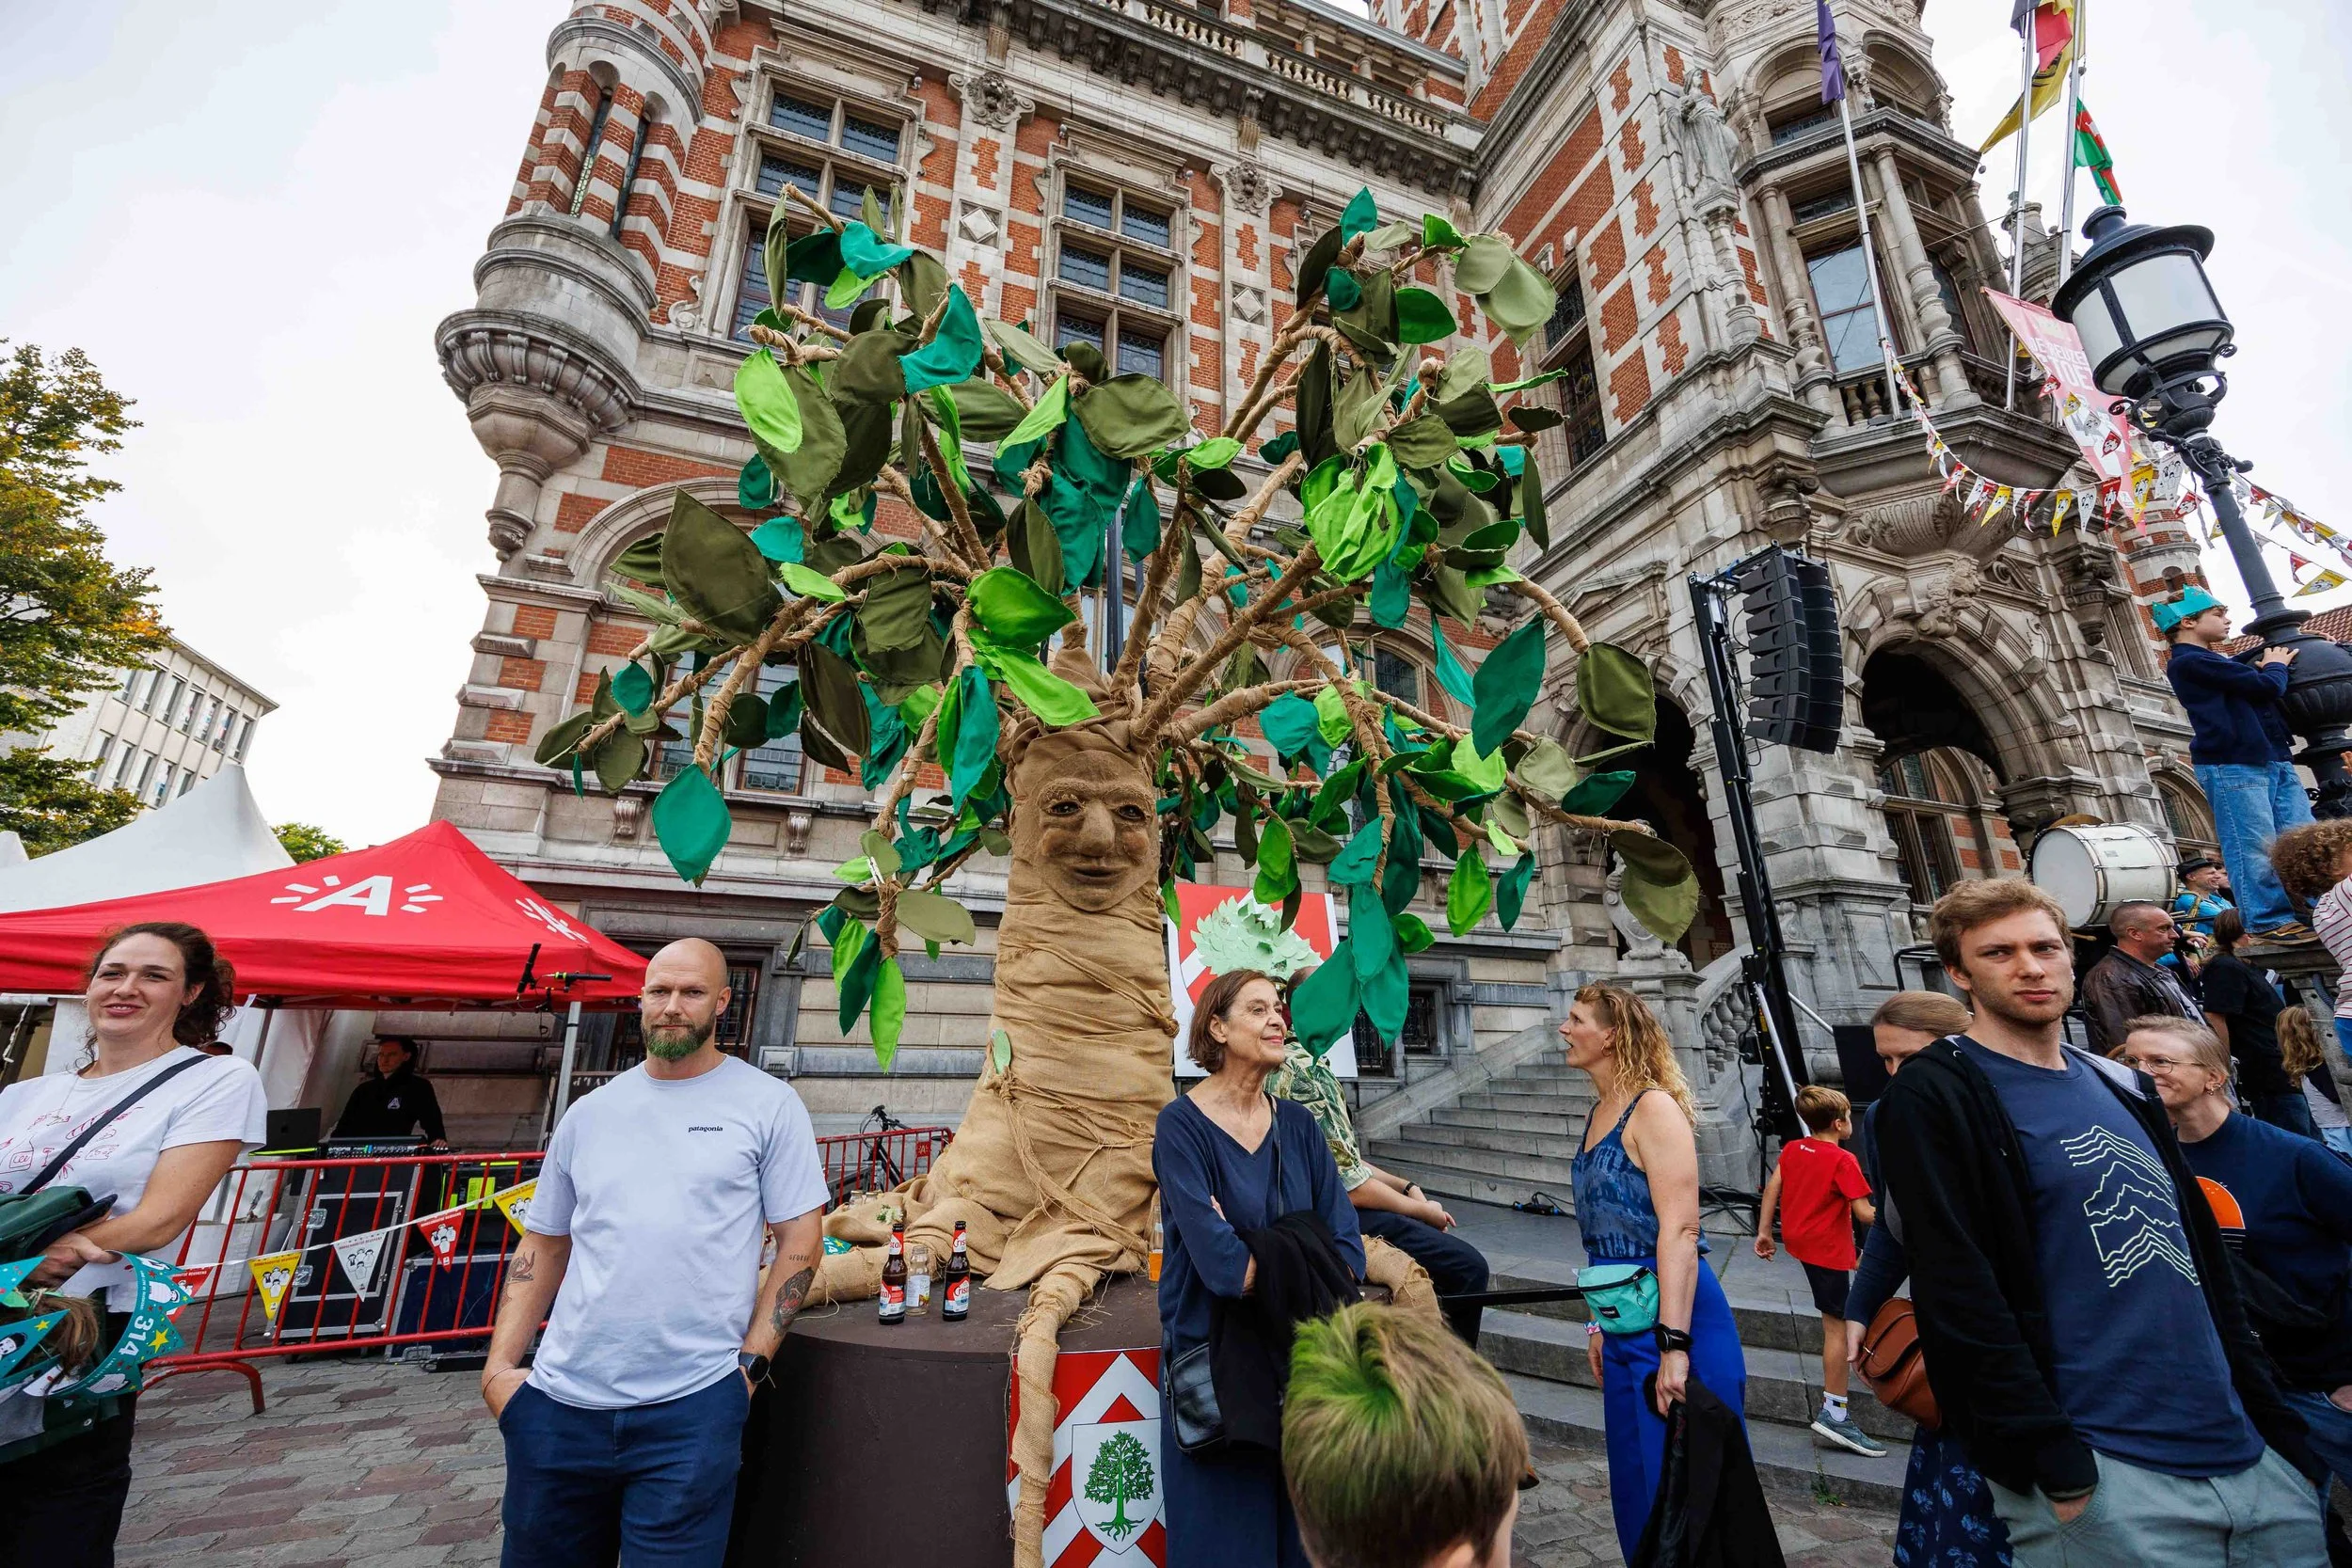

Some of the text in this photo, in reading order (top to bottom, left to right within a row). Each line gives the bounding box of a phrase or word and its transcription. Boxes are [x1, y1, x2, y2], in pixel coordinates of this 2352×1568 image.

[2046, 341, 2090, 367] REUZE
[293, 876, 393, 915] A
[119, 1315, 154, 1356] 314
